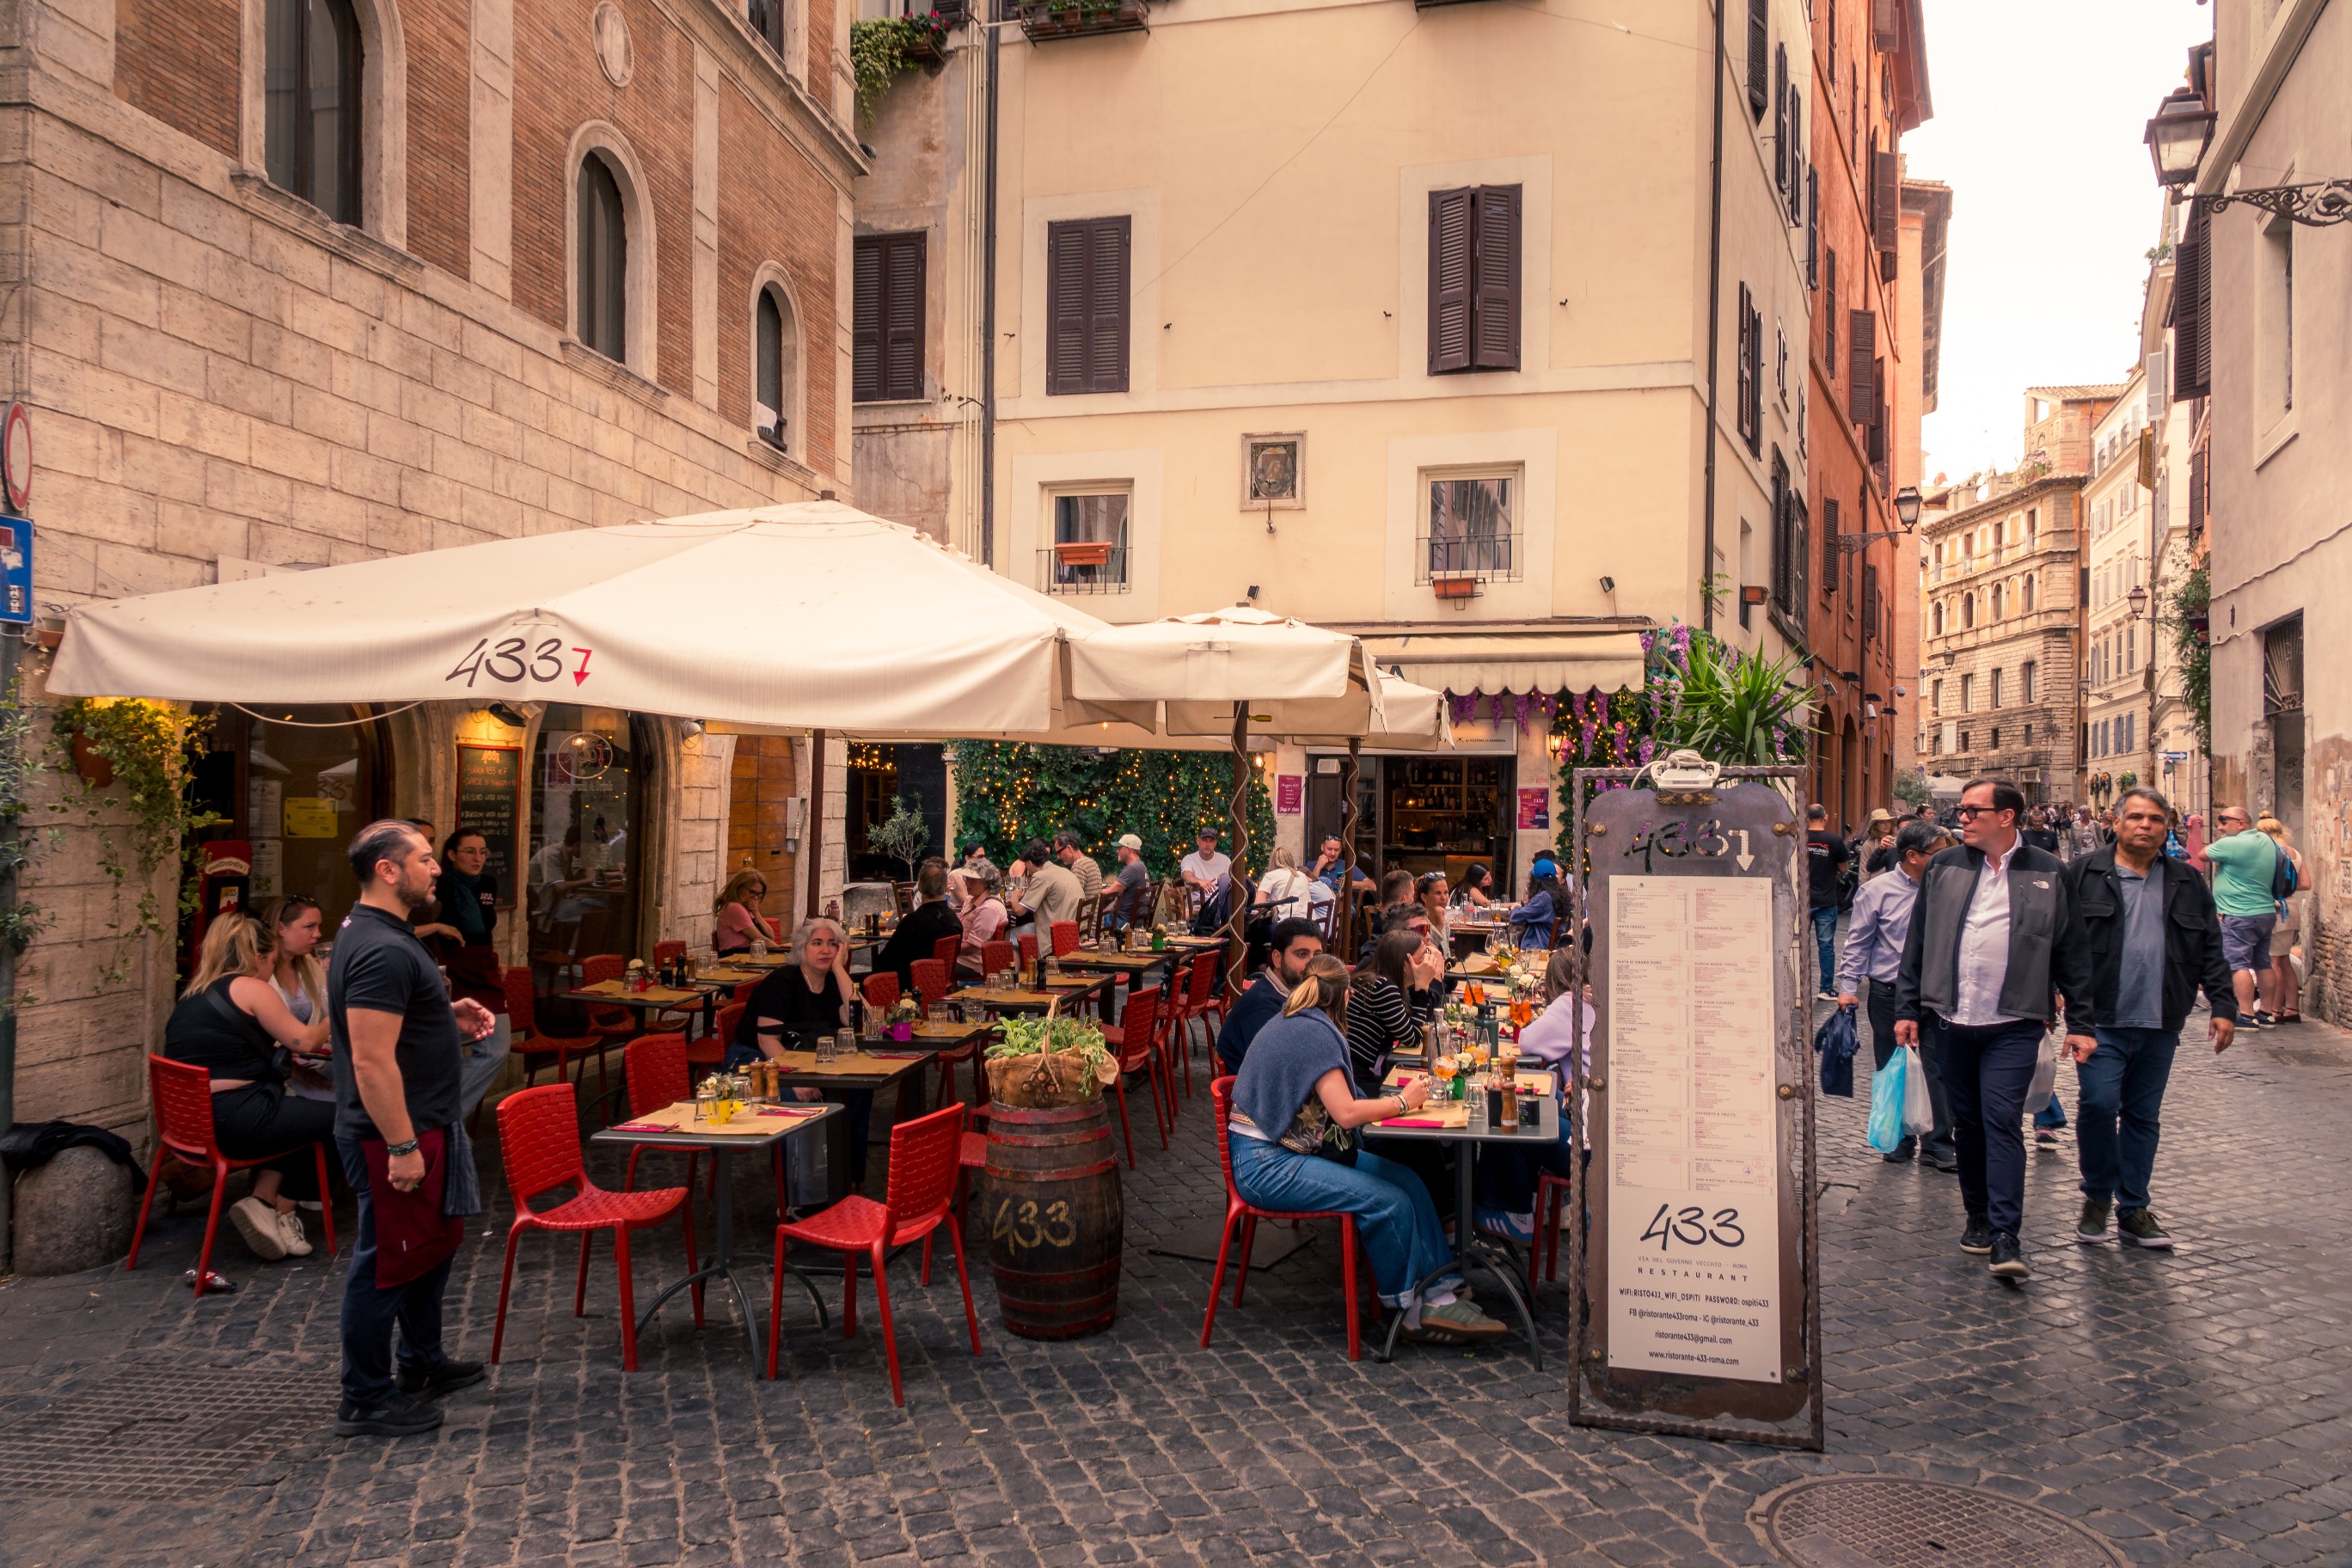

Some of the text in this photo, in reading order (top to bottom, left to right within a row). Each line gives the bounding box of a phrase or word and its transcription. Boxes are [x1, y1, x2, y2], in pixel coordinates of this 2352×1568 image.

[445, 638, 562, 688] 433
[1624, 820, 1729, 873] 433
[992, 1197, 1076, 1256] 433
[1639, 1204, 1745, 1251] 433
[1638, 1267, 1748, 1282] RESTAURANT
[1638, 1308, 1698, 1321] @ristorante433roma
[1711, 1315, 1759, 1327] @ristorante_433
[1705, 1295, 1740, 1305] PASSWORD:
[1741, 1298, 1769, 1308] ospiti433
[1648, 1351, 1739, 1366] www.ristorante-433-roma.com
